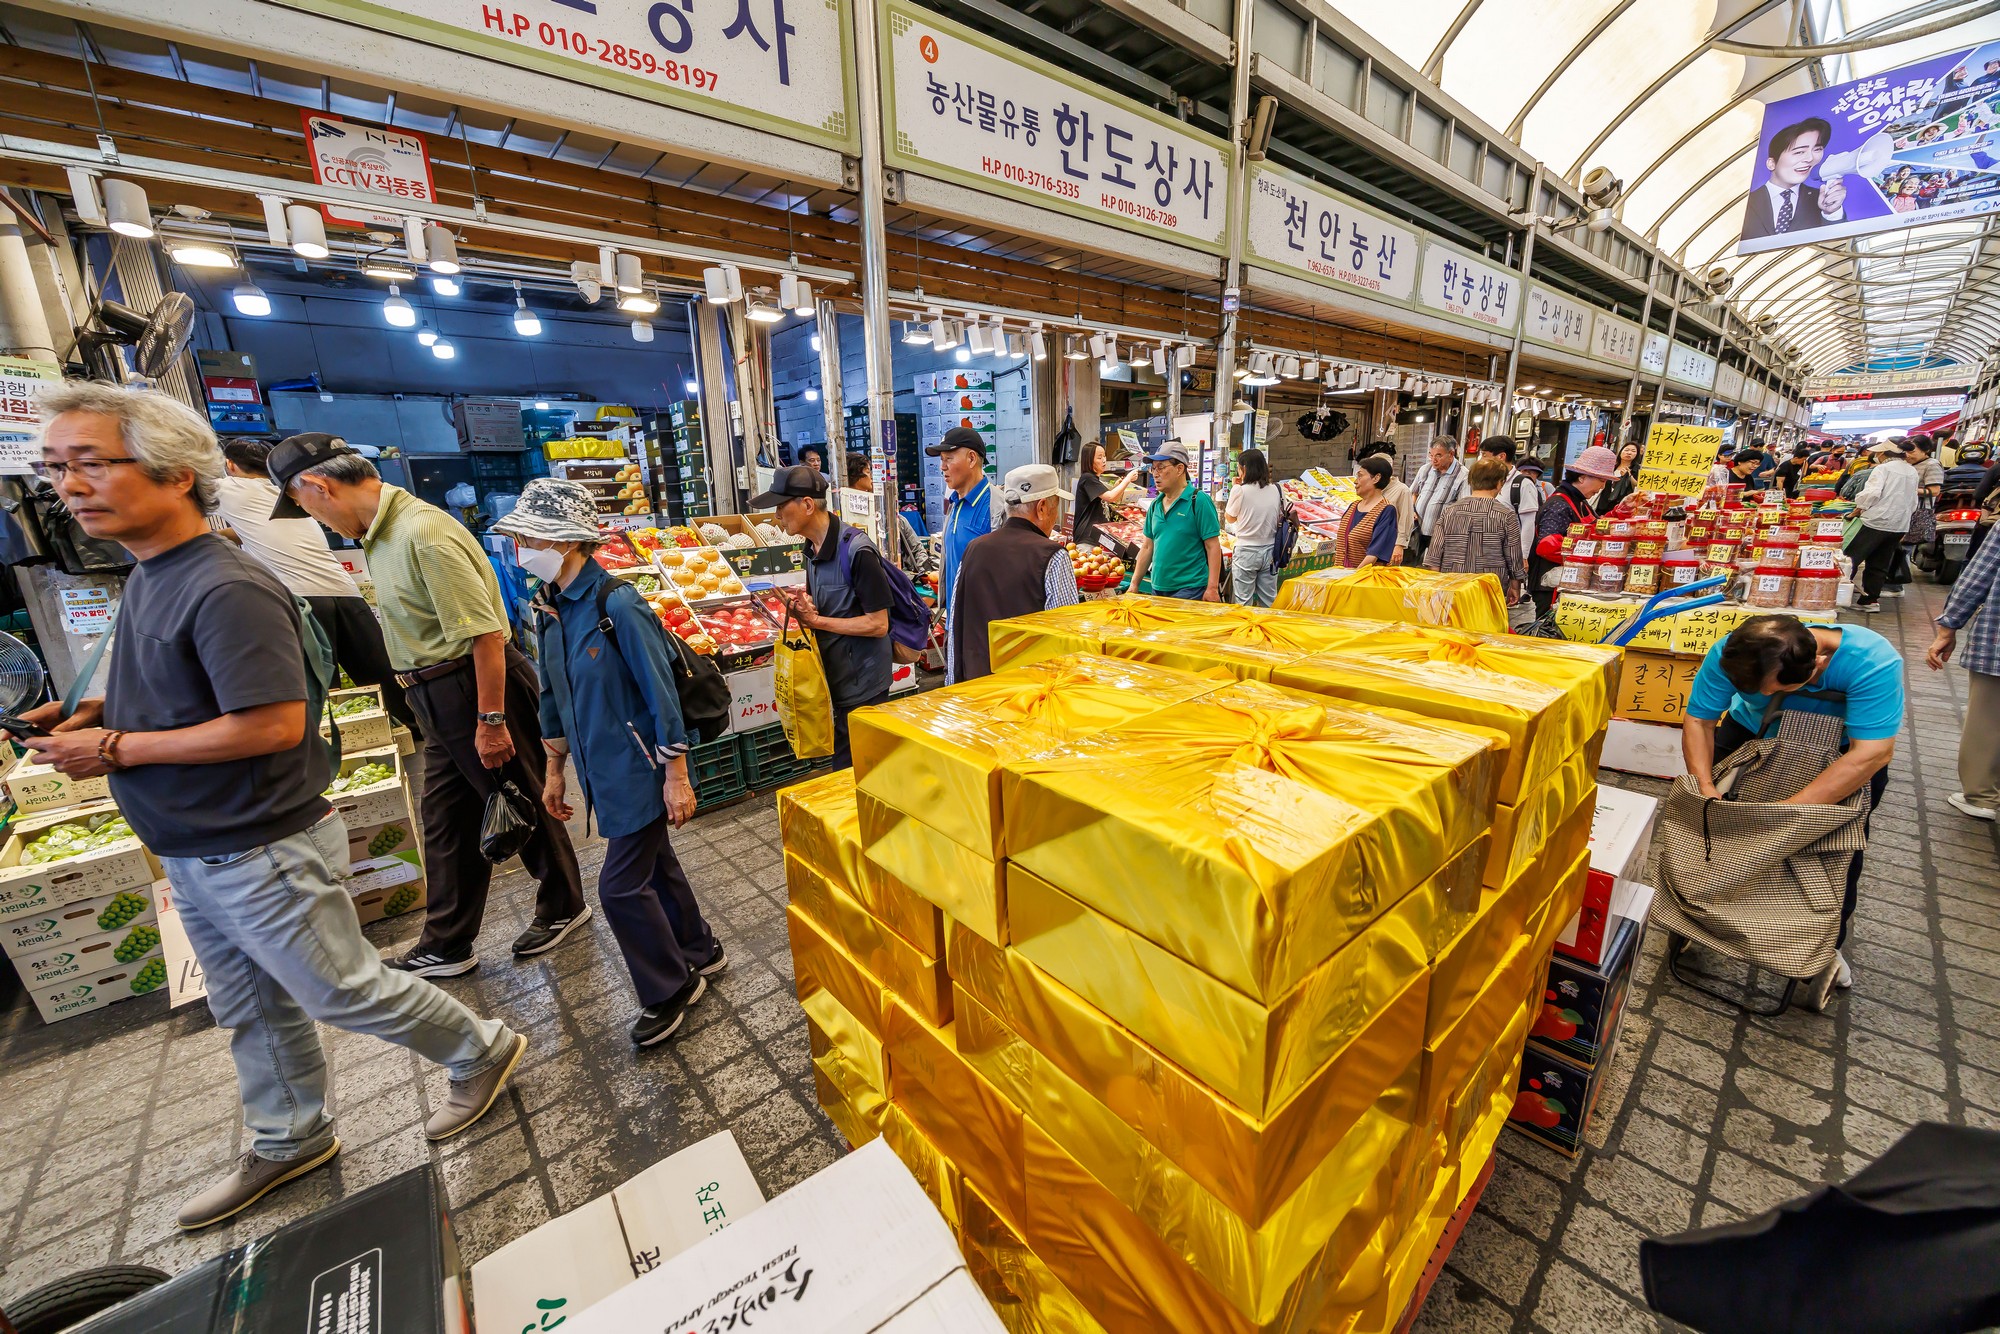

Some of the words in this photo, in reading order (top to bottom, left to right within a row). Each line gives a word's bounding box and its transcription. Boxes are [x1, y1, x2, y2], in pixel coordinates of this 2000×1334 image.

[481, 4, 531, 38] H.P
[537, 21, 719, 93] 010-2859-8197
[924, 42, 934, 60] 4
[1831, 77, 1889, 115] 전국팔도
[1847, 77, 1935, 122] 으쌰라
[926, 71, 1041, 147] 농산물유통
[1052, 102, 1214, 220] 한도상사
[323, 166, 372, 189] CCTV
[375, 173, 427, 199] 작동중
[982, 155, 1003, 176] H.P
[1003, 164, 1081, 199] 010-3716-5335
[1101, 193, 1118, 210] H.P
[1117, 199, 1178, 228] 010-3126-7289
[1284, 195, 1397, 280] 천안농산
[1307, 259, 1336, 278] T.962-6576
[1443, 258, 1509, 318] 한농상회
[1537, 299, 1584, 342] 우성상회
[734, 654, 753, 666] 사과
[741, 703, 769, 718] 사과
[25, 791, 67, 806] 샤인머스켓
[0, 896, 48, 915] 샤인머스켓
[17, 929, 63, 948] 샤인머스켓
[35, 963, 80, 982] 샤인머스켓
[54, 995, 98, 1014] 샤인머스켓
[761, 1245, 798, 1275] FRESH
[706, 1269, 759, 1307] YEONGJU
